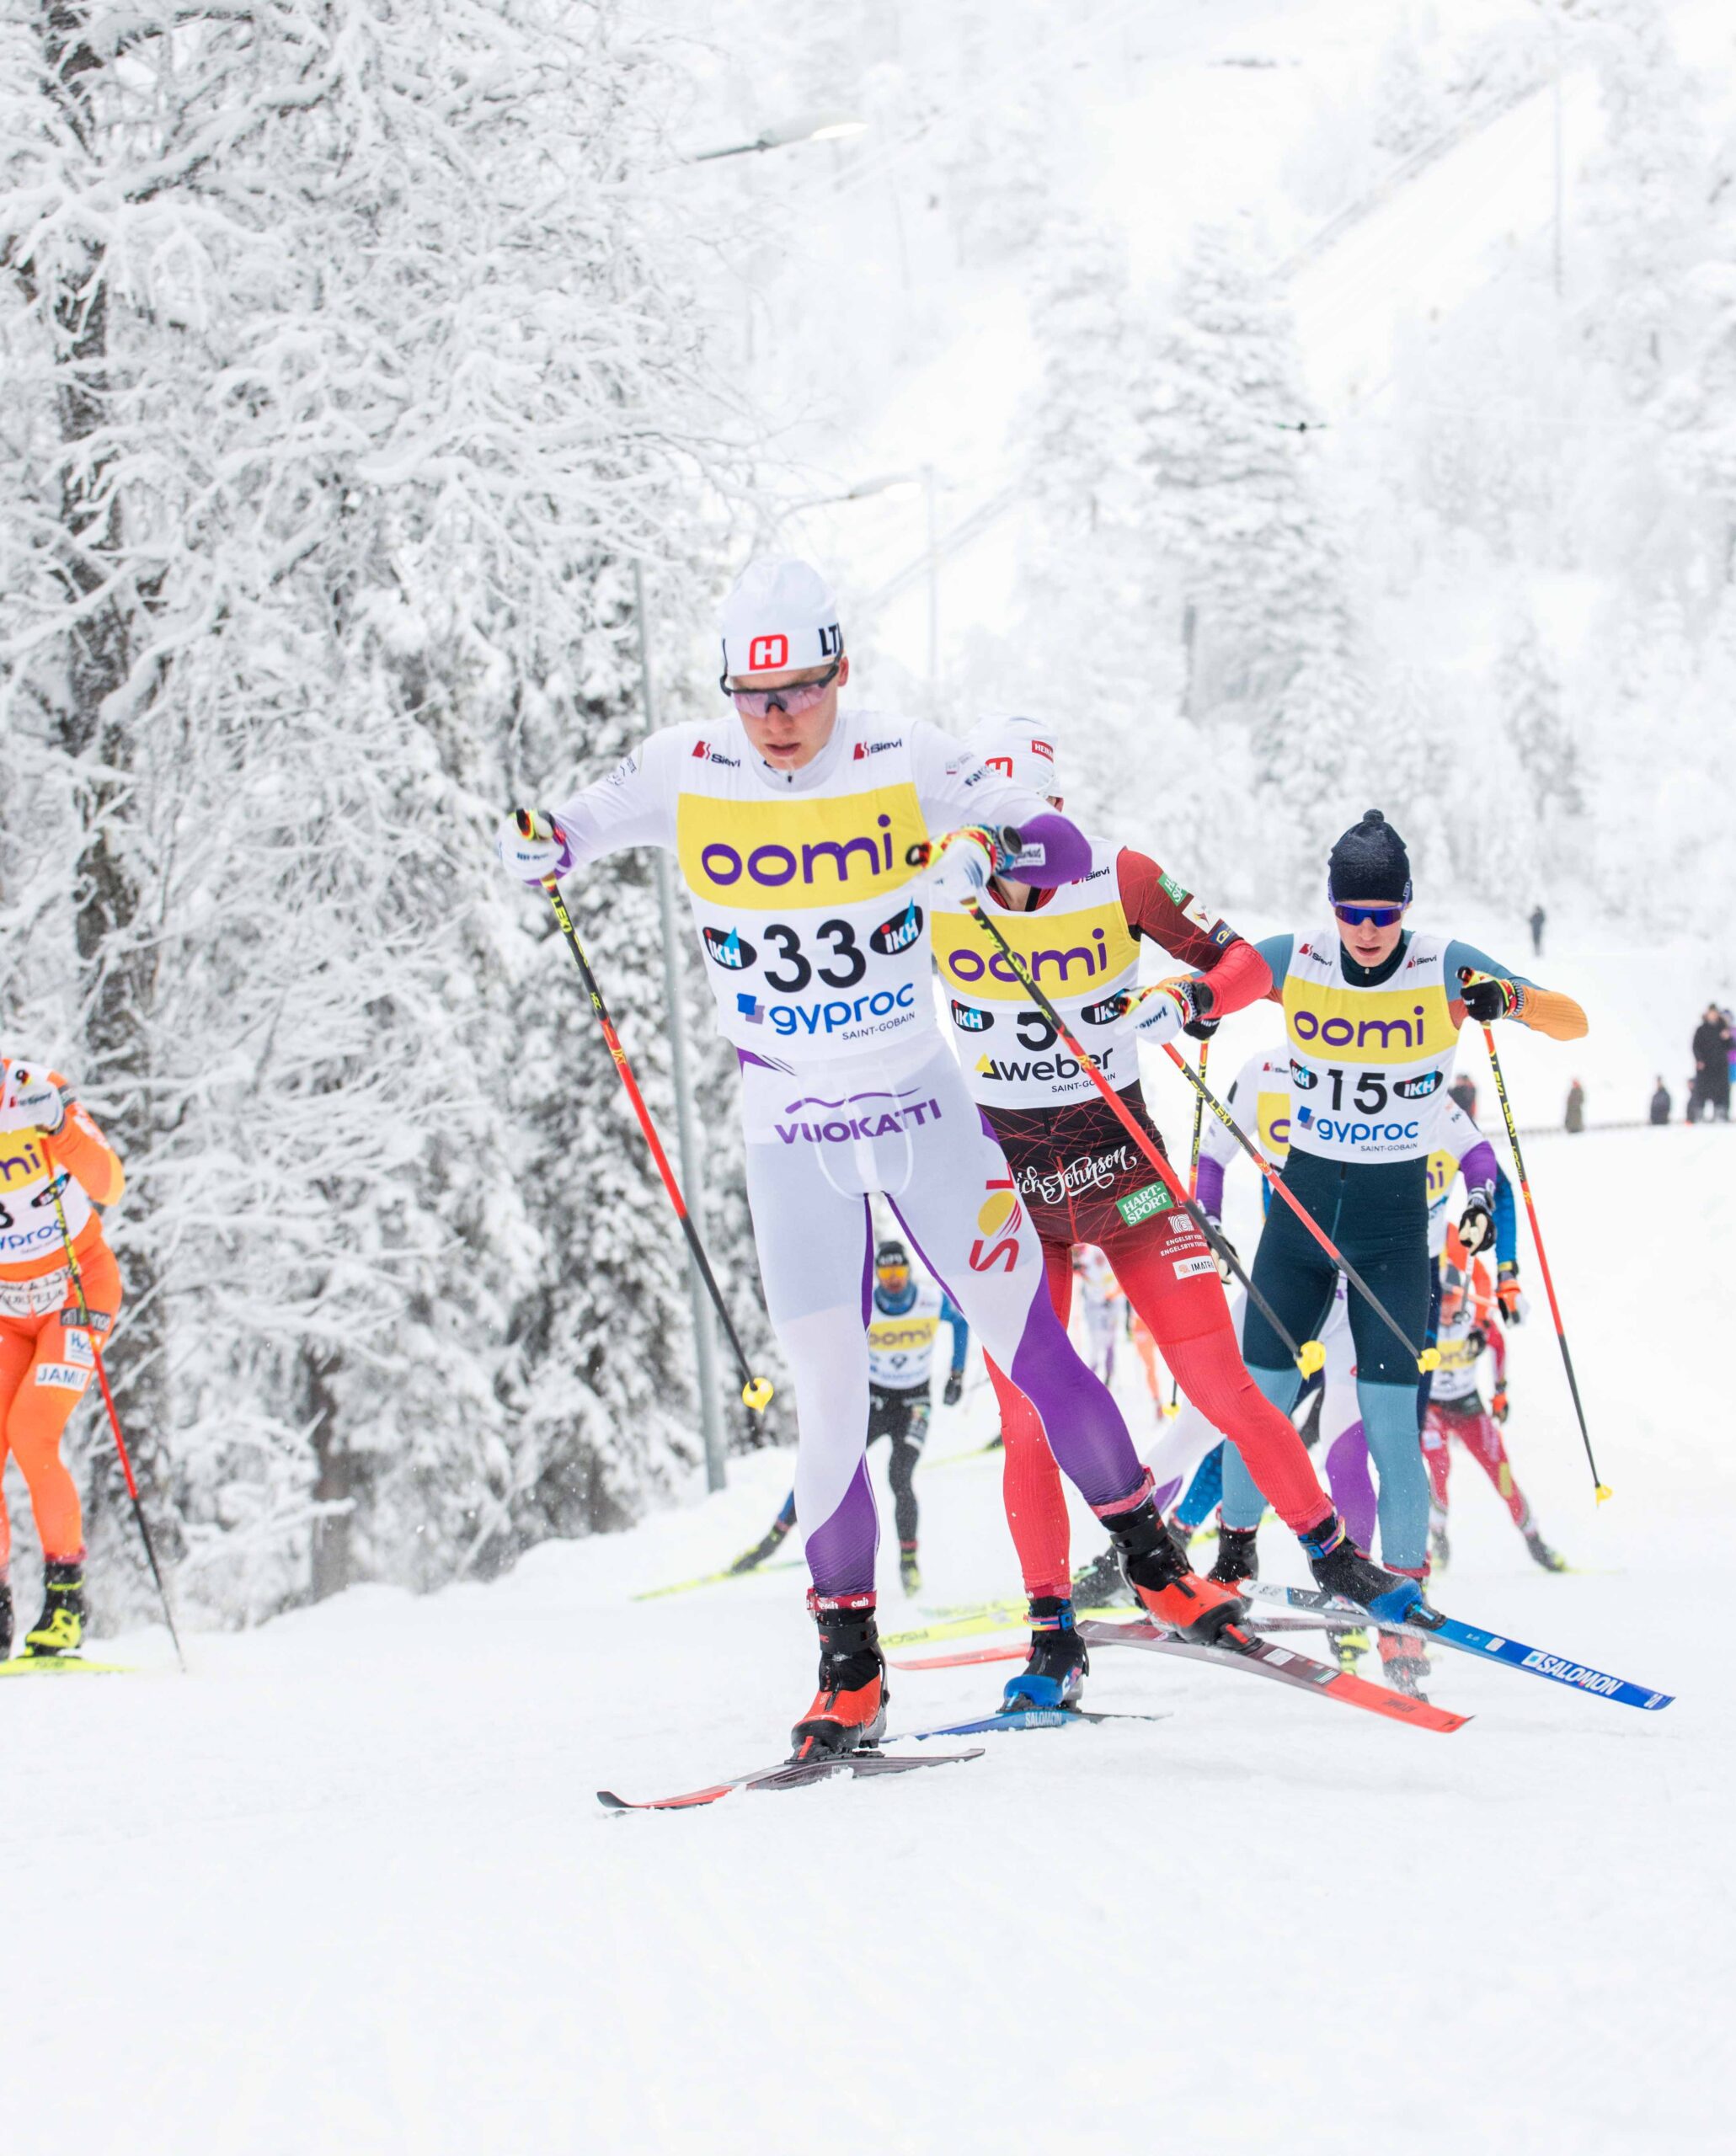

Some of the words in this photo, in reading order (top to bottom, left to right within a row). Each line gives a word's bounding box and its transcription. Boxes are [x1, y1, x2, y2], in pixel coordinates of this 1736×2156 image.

[711, 753, 741, 768] Sievi
[870, 739, 903, 755] Sievi
[702, 814, 893, 887] oomi
[763, 919, 867, 993] 33
[948, 928, 1108, 983] oomi
[1416, 954, 1439, 966] Sievi
[769, 983, 915, 1036] gyproc
[842, 1011, 916, 1040] SAINT-GOBAIN
[1294, 1006, 1424, 1049] oomi
[1327, 1068, 1388, 1115] 15
[774, 1098, 943, 1145] VUOKATTI
[1317, 1119, 1418, 1145] gyproc
[1360, 1142, 1418, 1152] SAINT-GOBAIN
[1123, 1184, 1162, 1215] HART-
[1127, 1192, 1167, 1225] SPORT
[1539, 1657, 1624, 1696] SALOMON
[1025, 1711, 1063, 1727] SALOMON
